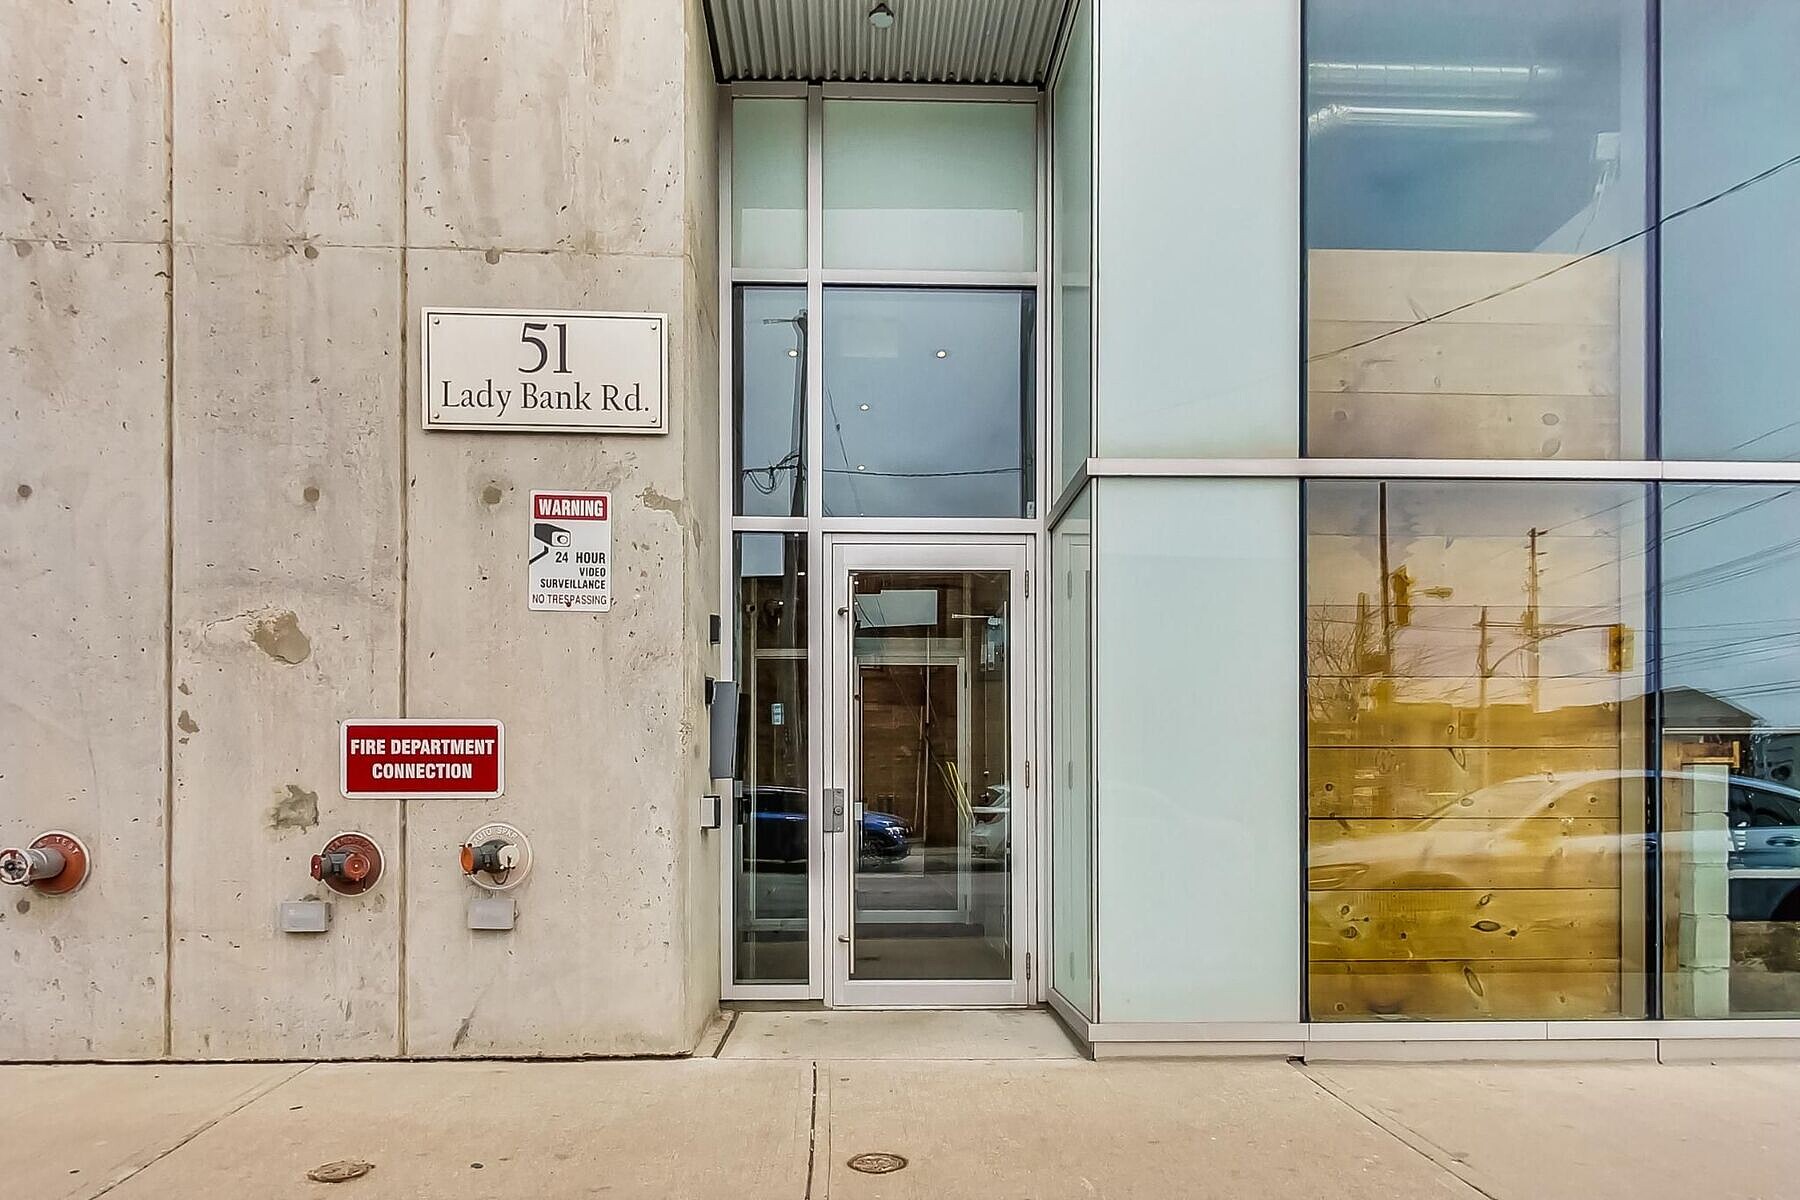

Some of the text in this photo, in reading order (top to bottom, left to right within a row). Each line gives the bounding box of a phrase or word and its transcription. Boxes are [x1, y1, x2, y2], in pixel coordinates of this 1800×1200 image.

[518, 322, 572, 374] 51
[441, 379, 649, 417] Lady Bank Rd.
[538, 499, 604, 517] WARNING
[555, 551, 606, 564] 24 HOUR
[579, 567, 606, 577] VIDEO
[540, 579, 606, 589] SURVEILLANCE
[532, 594, 607, 605] NO TRESPASSING
[350, 739, 495, 755] FIRE DEPARTMENT
[372, 763, 473, 779] CONNECTION
